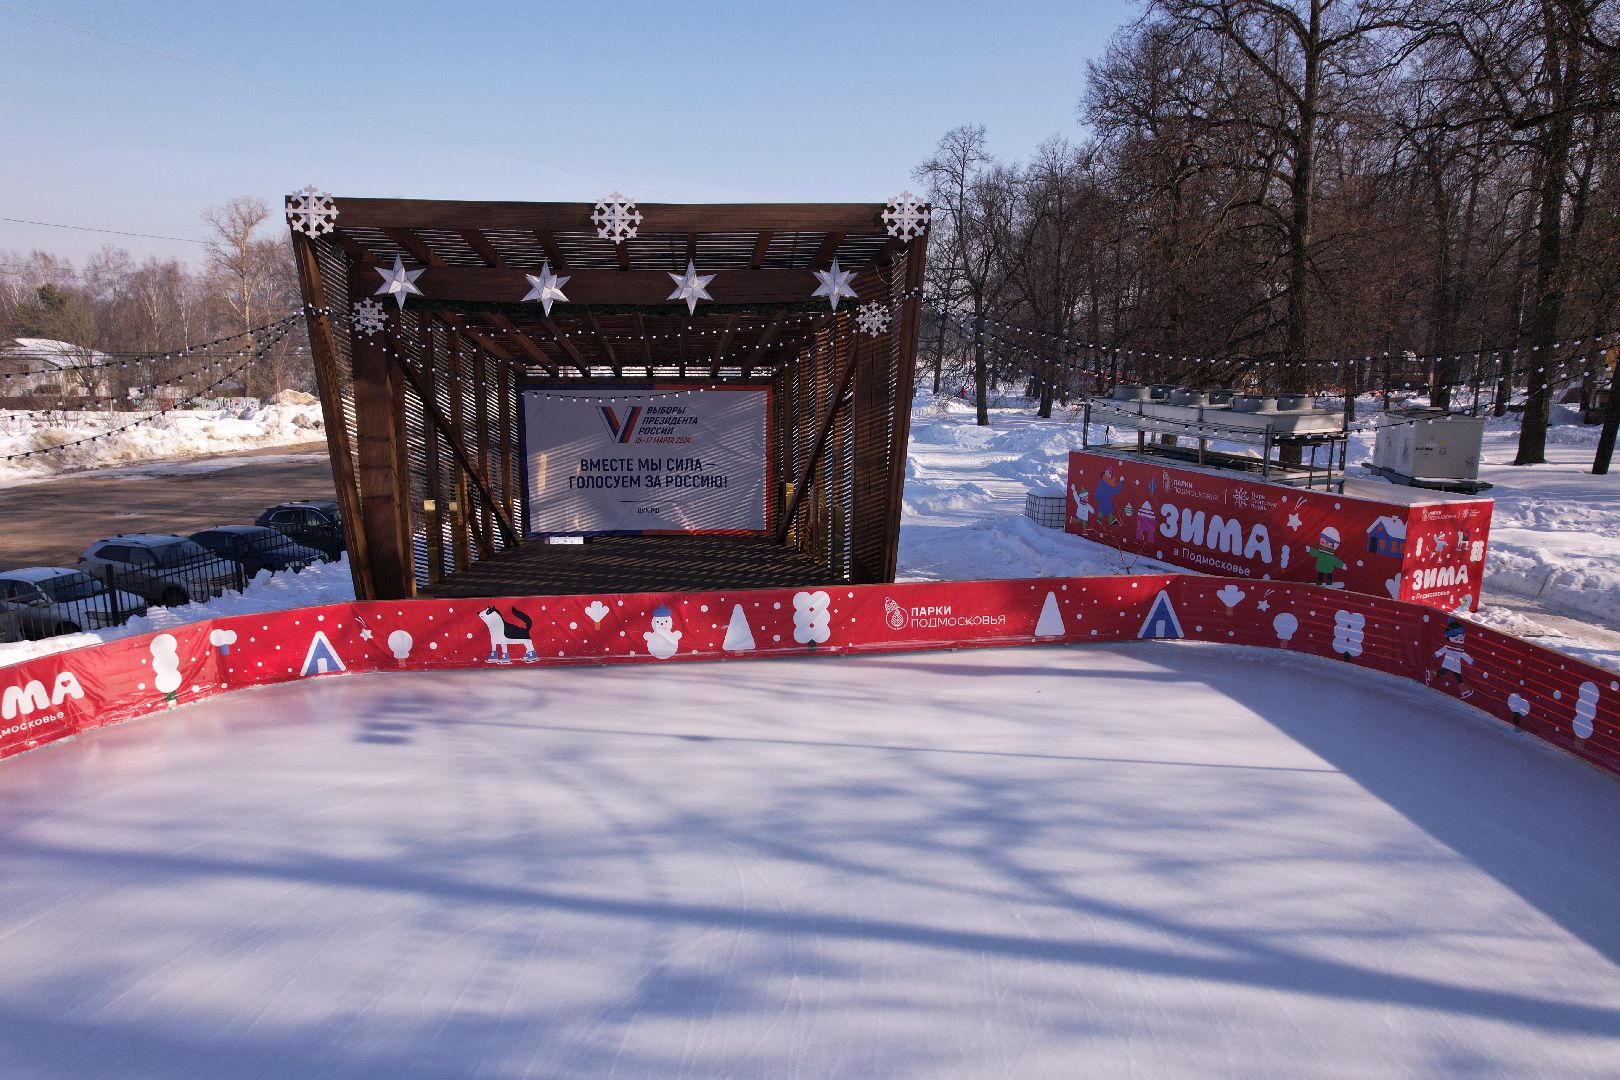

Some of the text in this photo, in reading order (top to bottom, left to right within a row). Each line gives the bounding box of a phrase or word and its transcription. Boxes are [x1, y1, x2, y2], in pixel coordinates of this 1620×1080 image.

[646, 406, 687, 415] ВЫБОРЫ
[642, 416, 698, 426] ПРЕЗИДЕНТА
[638, 427, 675, 435] РОССИИ
[580, 458, 634, 472] ВМЕСТЕ
[638, 458, 662, 472] МЫ
[666, 457, 703, 471] СИЛА
[568, 474, 728, 489] ГОЛОСУЕМ ЗА РОССИЮ!
[1160, 503, 1273, 564] ЗИМА
[1173, 547, 1251, 577] в Подмосковье
[1412, 564, 1469, 591] ЗИМА
[911, 605, 952, 616] ПАРКИ
[911, 614, 1006, 628] ПОДМОСКОВЬЯ
[0, 711, 65, 739] московье
